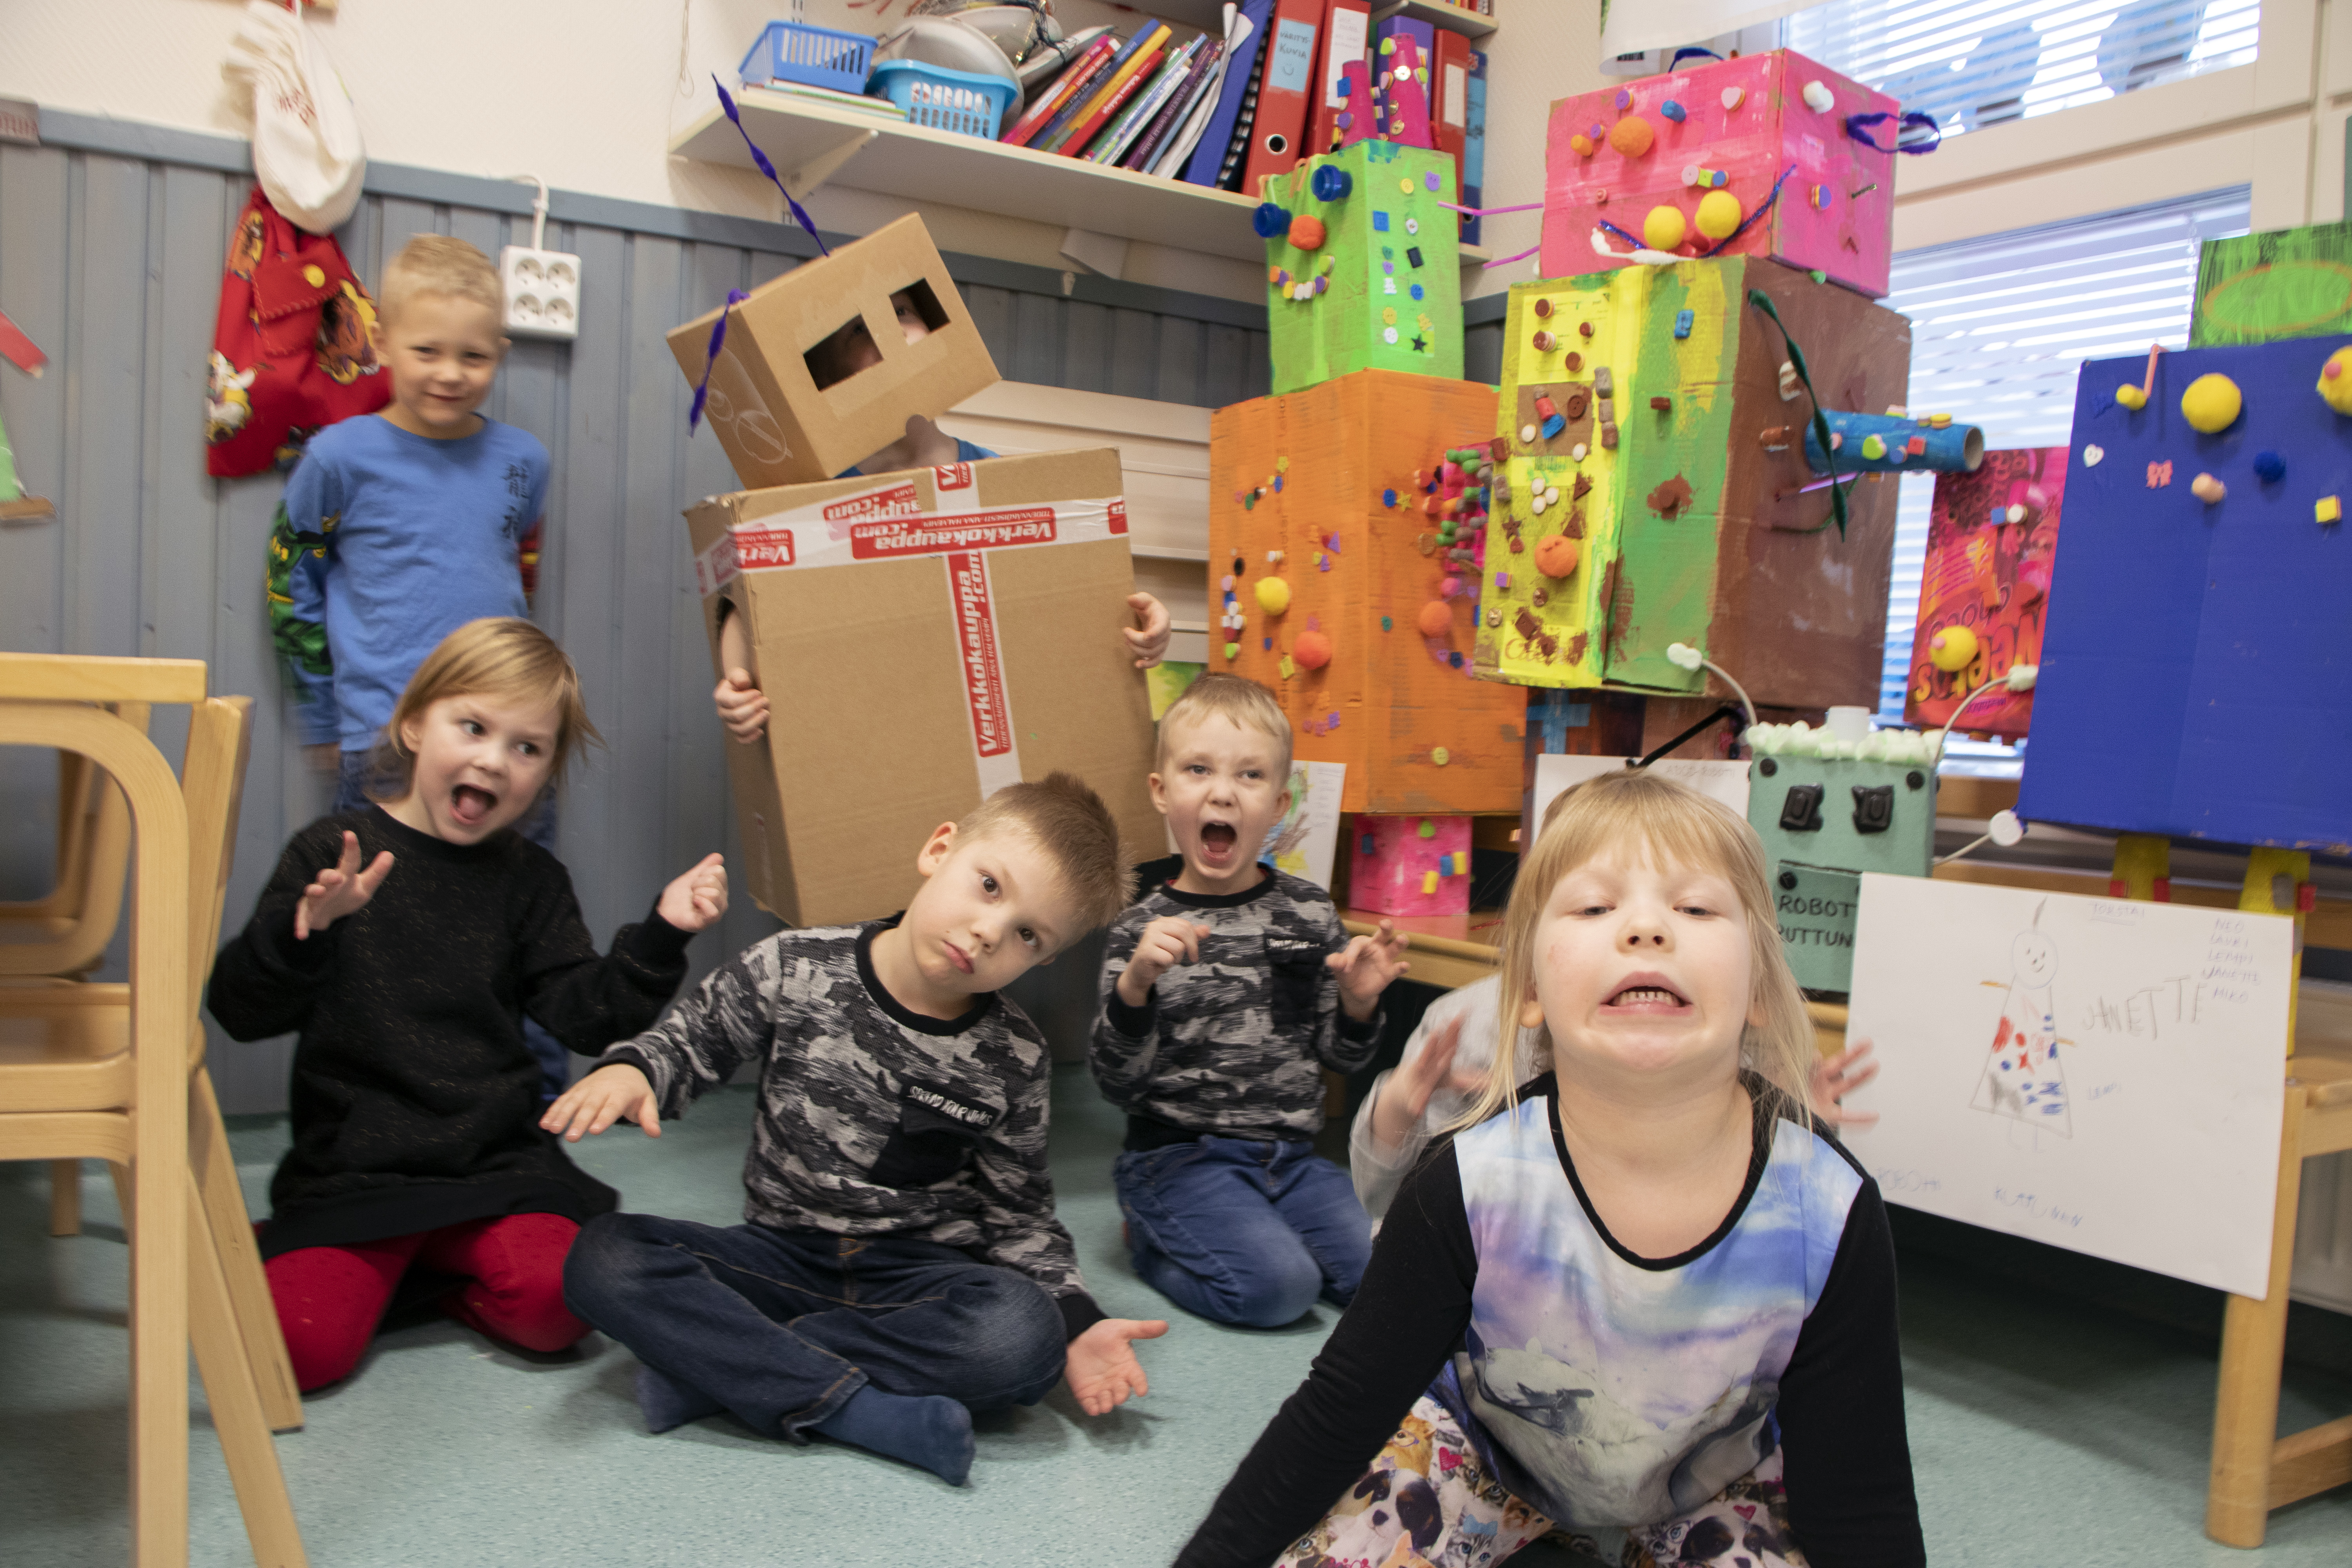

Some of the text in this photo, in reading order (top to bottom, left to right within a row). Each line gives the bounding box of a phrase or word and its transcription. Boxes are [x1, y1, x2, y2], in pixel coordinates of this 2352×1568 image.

[1165, 83, 1190, 116] FRANKLIN
[855, 523, 908, 538] .com
[875, 521, 1052, 550] Verkkokauppa
[958, 571, 998, 752] Verkkokauppa
[1779, 895, 1857, 918] ROBOT
